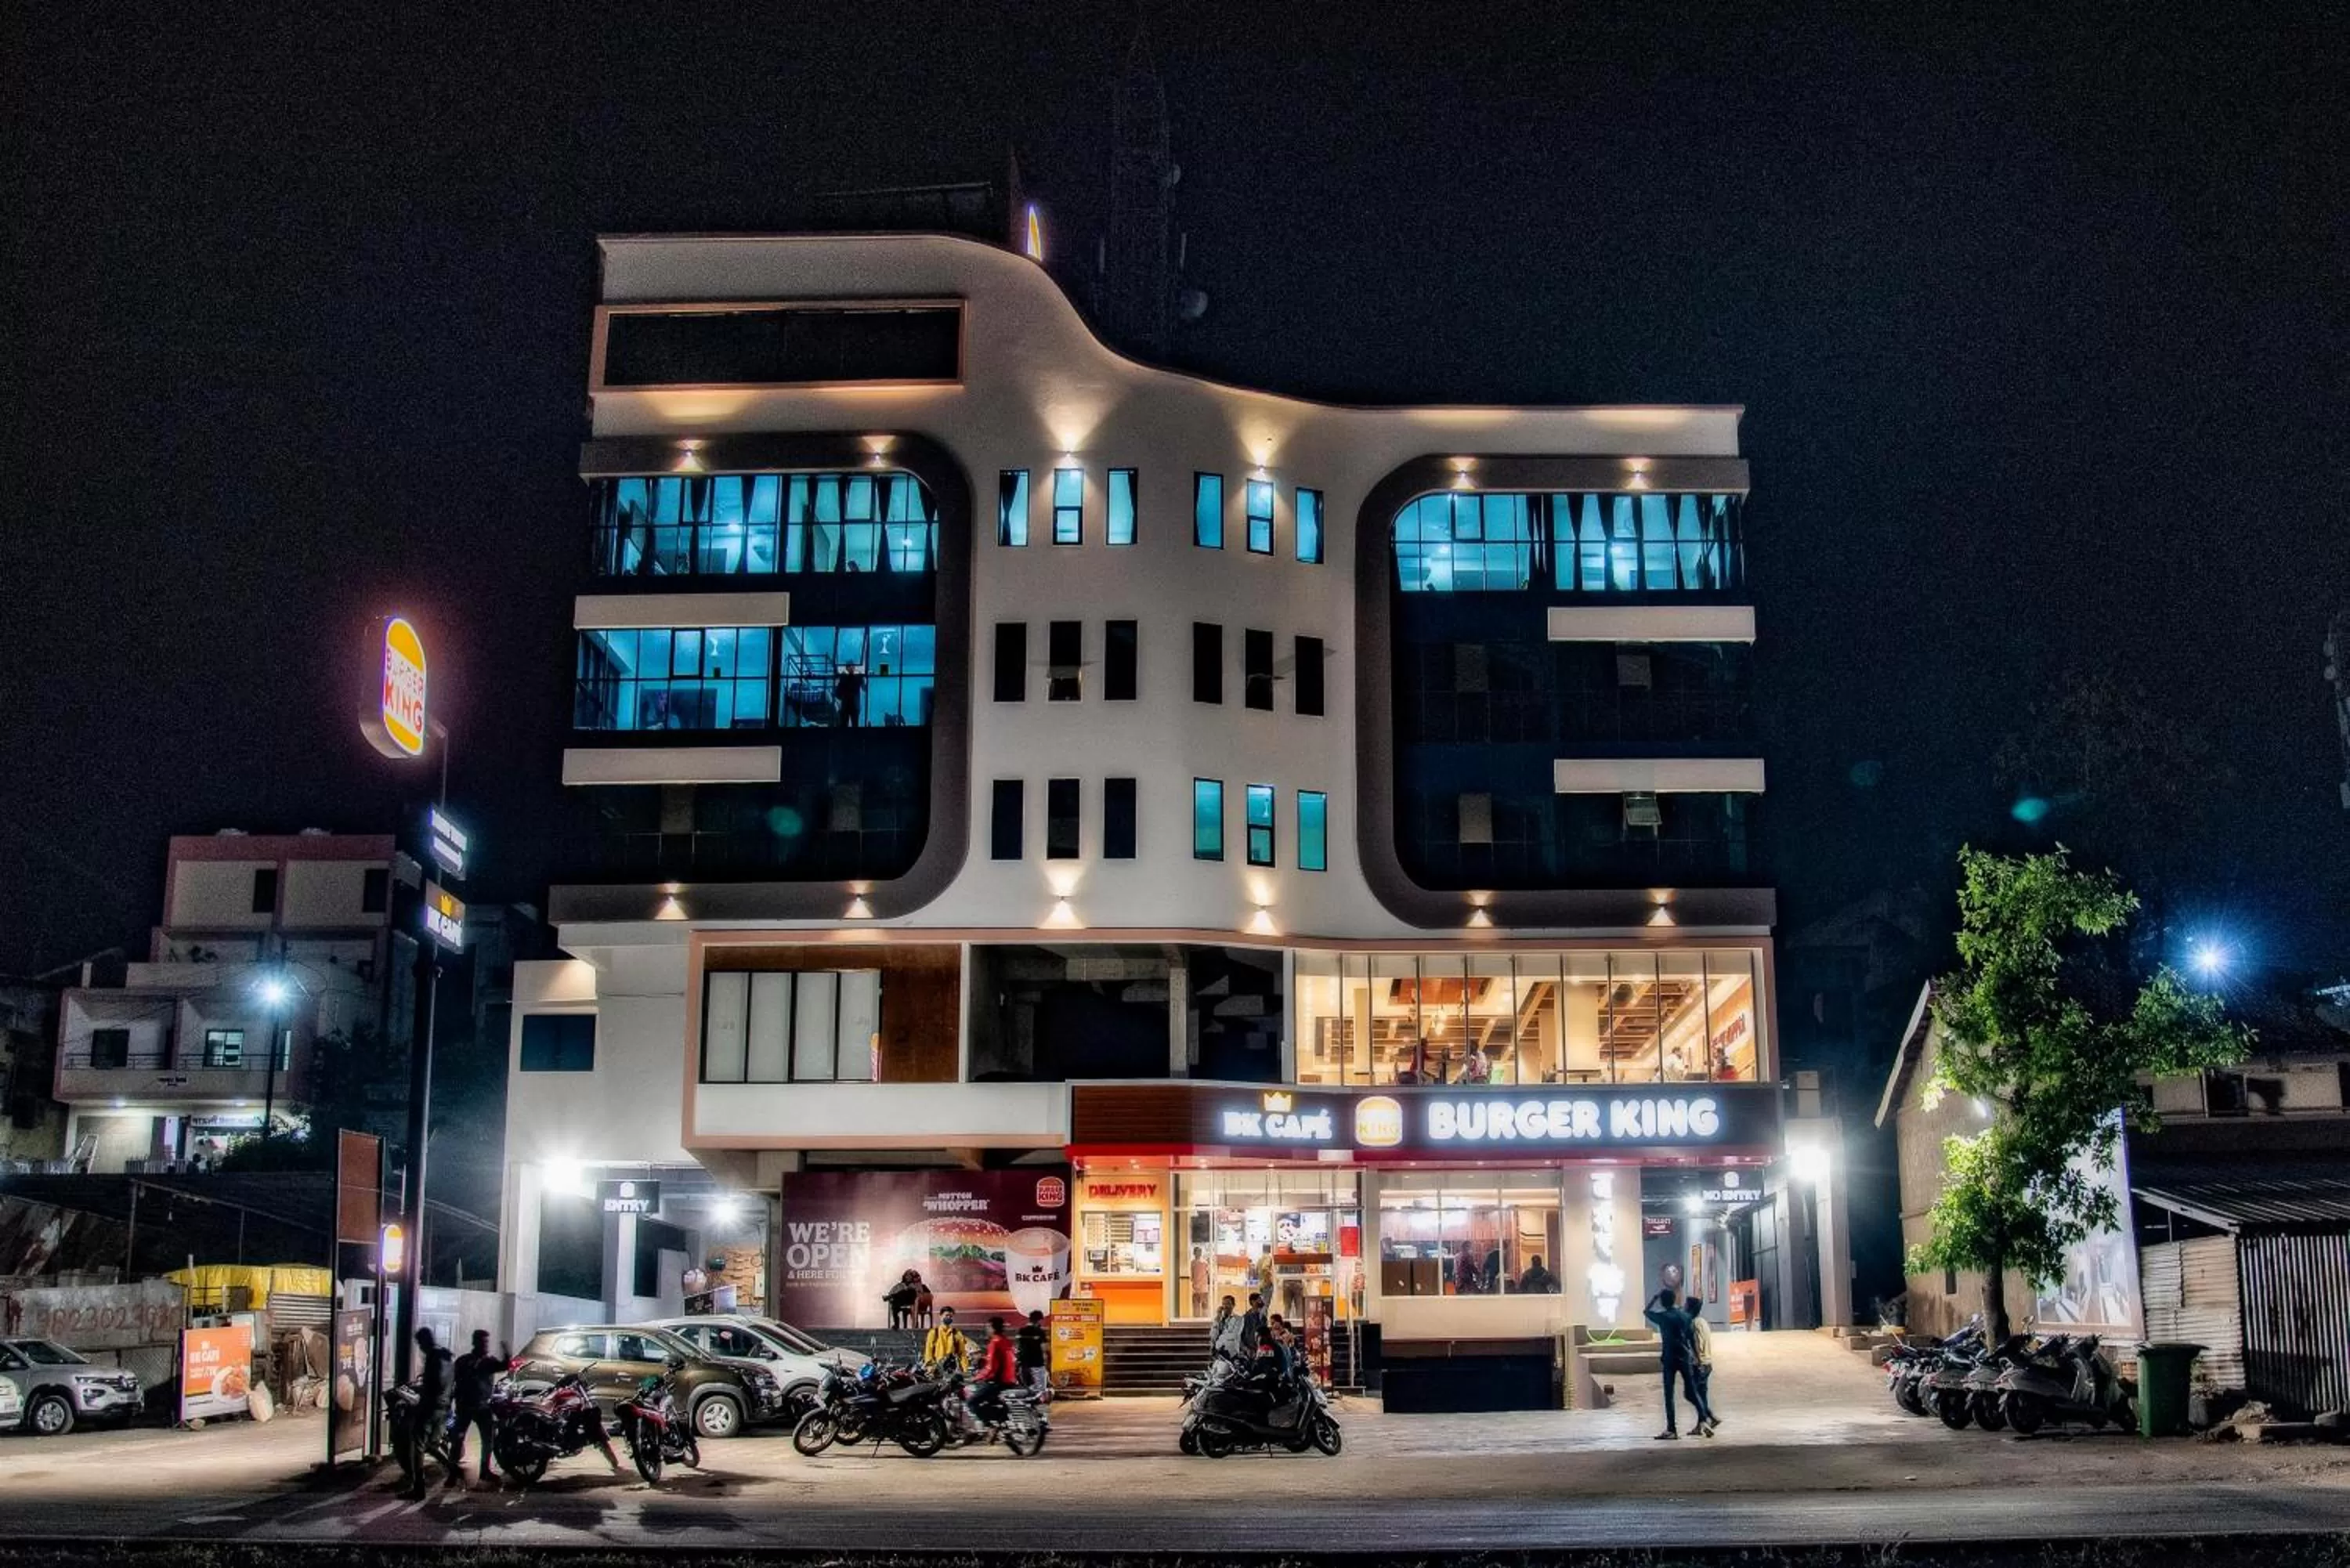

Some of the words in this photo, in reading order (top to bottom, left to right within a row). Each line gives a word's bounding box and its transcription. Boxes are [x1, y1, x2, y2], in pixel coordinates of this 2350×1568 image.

[385, 677, 422, 732] KING
[1428, 1100, 1601, 1140] BURGER
[1610, 1098, 1719, 1138] KING
[1089, 1183, 1157, 1198] DELIVERY
[1702, 1190, 1721, 1201] NO
[1722, 1190, 1761, 1201] ENTRY
[604, 1199, 649, 1212] ENTRY
[787, 1221, 870, 1243] WE'RE
[786, 1243, 870, 1270] OPEN
[797, 1270, 824, 1279] HERE
[1015, 1273, 1030, 1282] BK
[1032, 1268, 1060, 1282] CAFÉ
